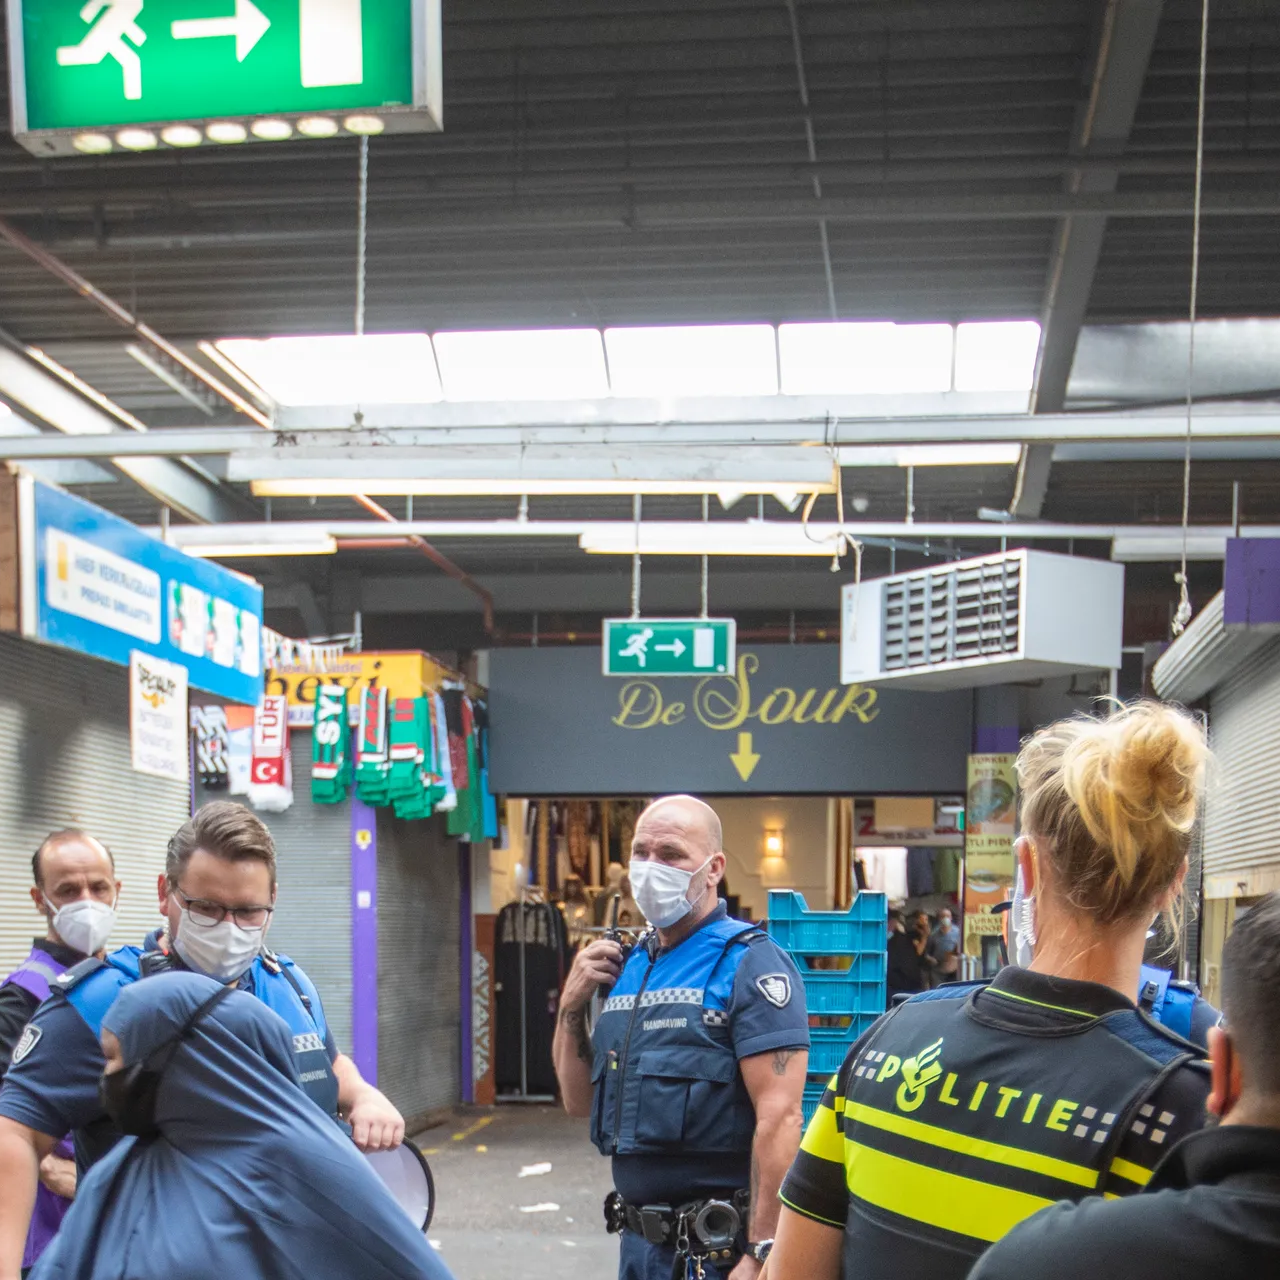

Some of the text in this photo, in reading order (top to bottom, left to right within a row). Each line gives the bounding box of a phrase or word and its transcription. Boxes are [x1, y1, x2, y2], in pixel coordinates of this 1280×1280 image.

[612, 680, 687, 729] De
[642, 1017, 688, 1031] HANDHAVING
[876, 1054, 1079, 1132] POLITIE
